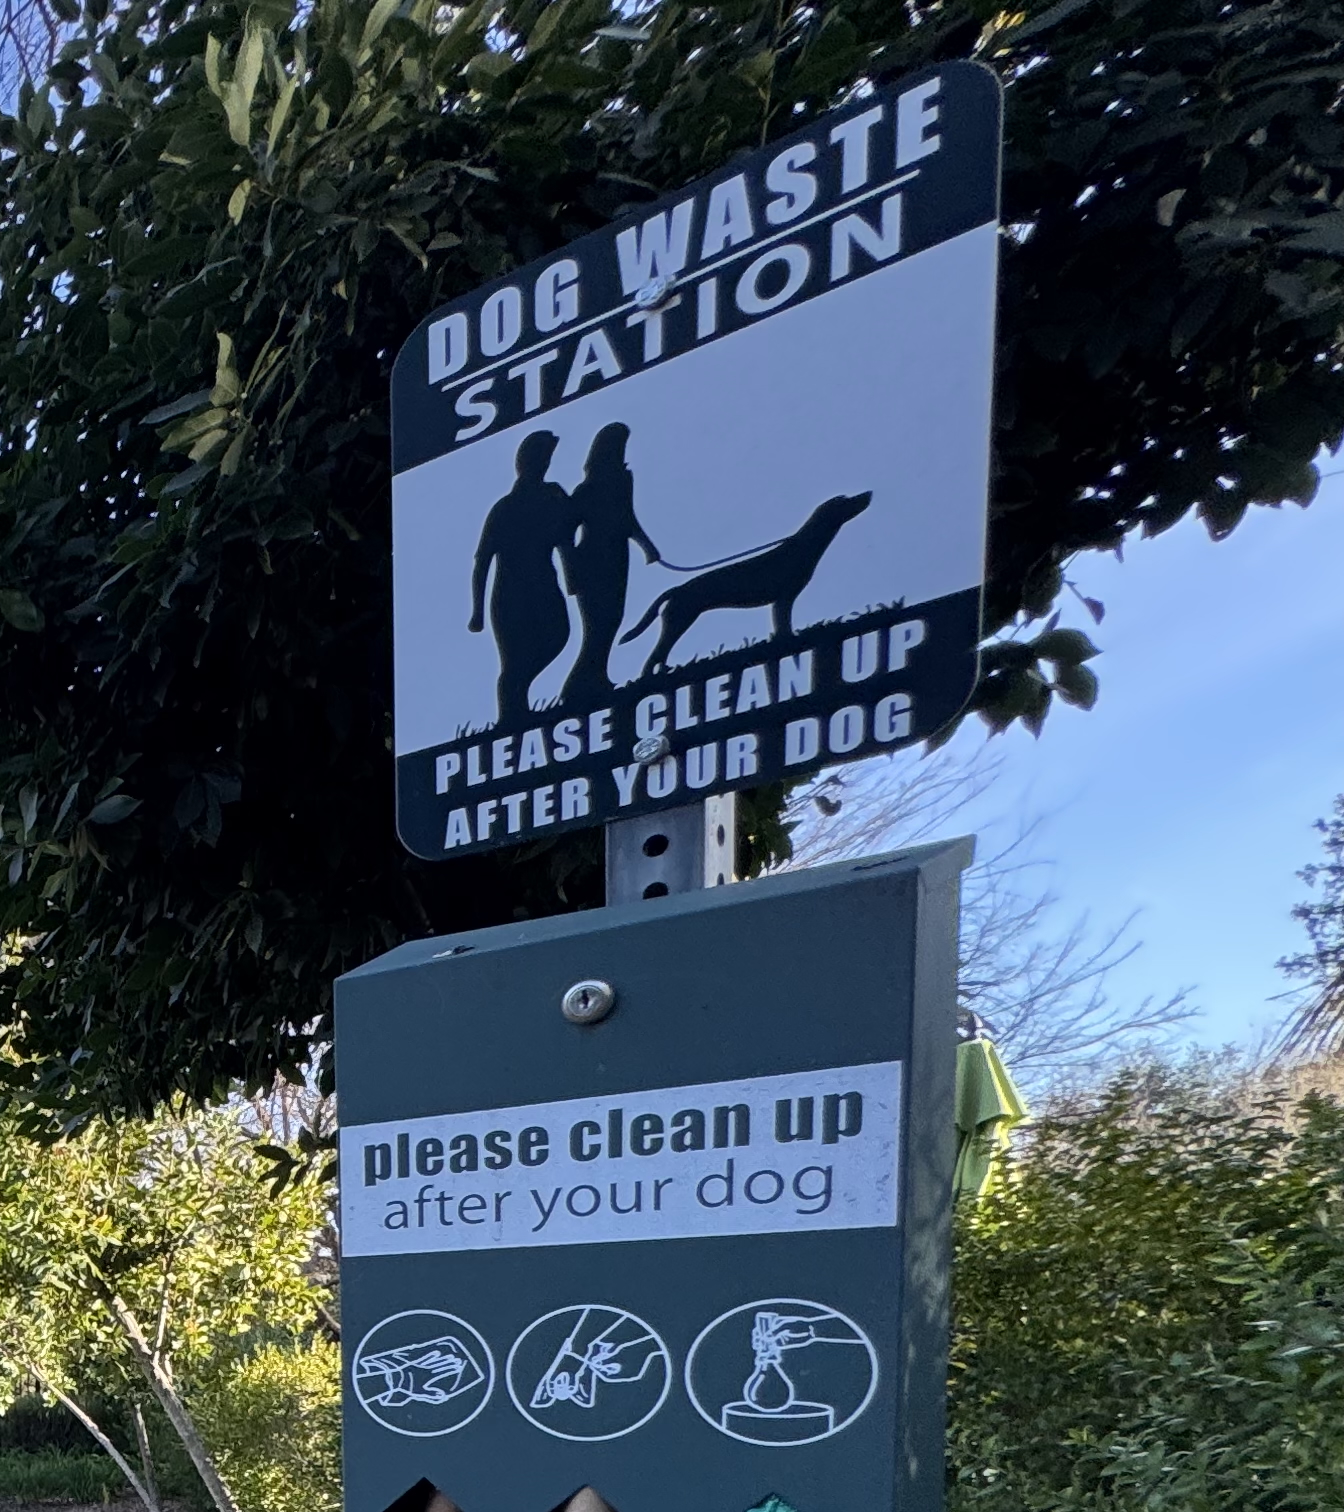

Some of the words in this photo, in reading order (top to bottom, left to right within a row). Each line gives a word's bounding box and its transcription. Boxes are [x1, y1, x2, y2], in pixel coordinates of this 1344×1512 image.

[428, 258, 580, 385] DOG
[616, 76, 942, 297] WASTE
[454, 192, 903, 443] STATION
[435, 707, 612, 796] PLEASE
[635, 649, 813, 741] CLEAN
[840, 619, 926, 684] UP
[443, 777, 592, 851] AFTER
[611, 733, 759, 808] YOUR
[785, 692, 914, 767] DOG
[363, 1124, 550, 1188] please
[568, 1101, 752, 1164] clean
[774, 1090, 864, 1146] up
[383, 1183, 513, 1231] after
[530, 1176, 674, 1233] your
[695, 1157, 835, 1215] dog
